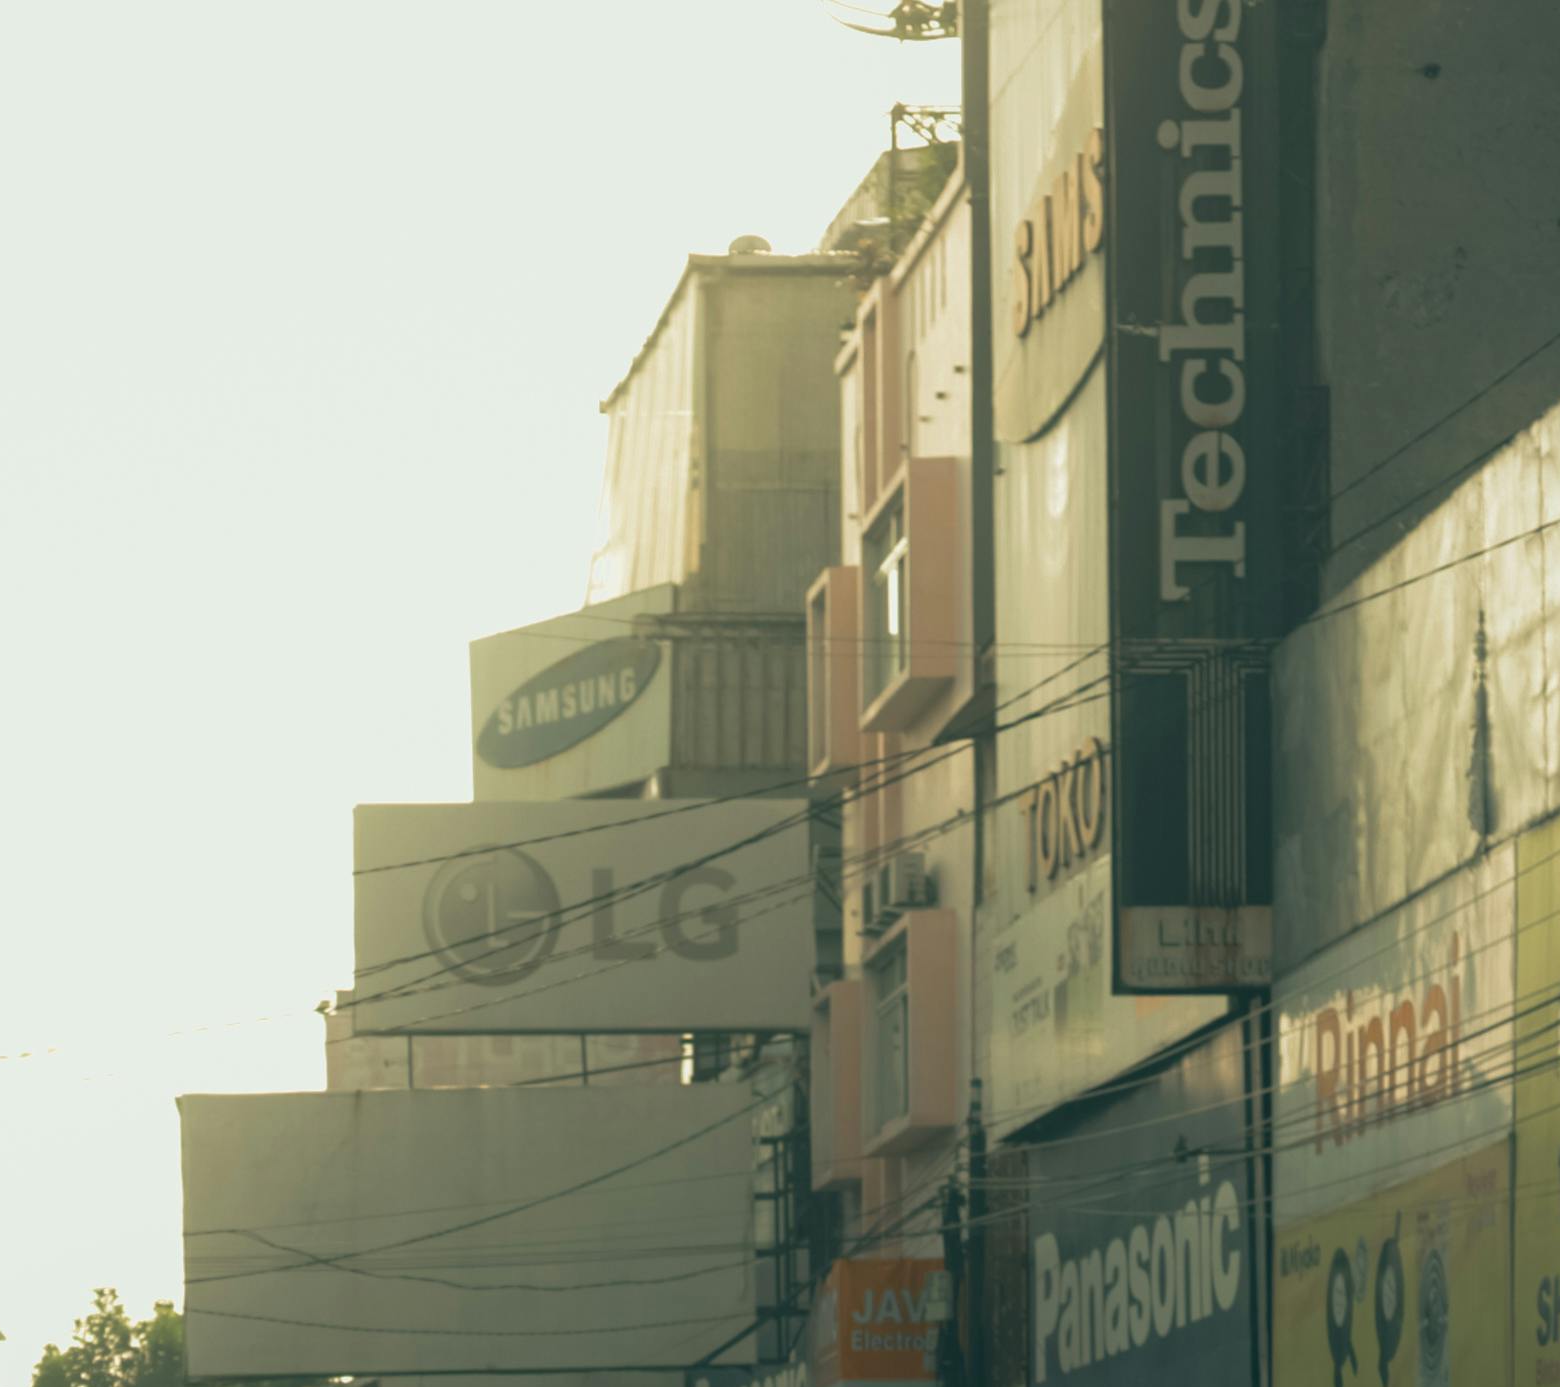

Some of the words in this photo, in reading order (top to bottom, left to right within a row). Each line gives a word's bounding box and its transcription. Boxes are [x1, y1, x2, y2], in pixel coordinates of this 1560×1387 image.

[1158, 0, 1246, 602] Technics
[497, 665, 637, 735] SAMSUNG
[1019, 737, 1104, 893] TOKO
[591, 866, 740, 962] LG
[1315, 930, 1461, 1156] Rinnai
[851, 1288, 929, 1325] JAV
[1034, 1155, 1240, 1385] Panasonic
[850, 1328, 929, 1352] Electro
